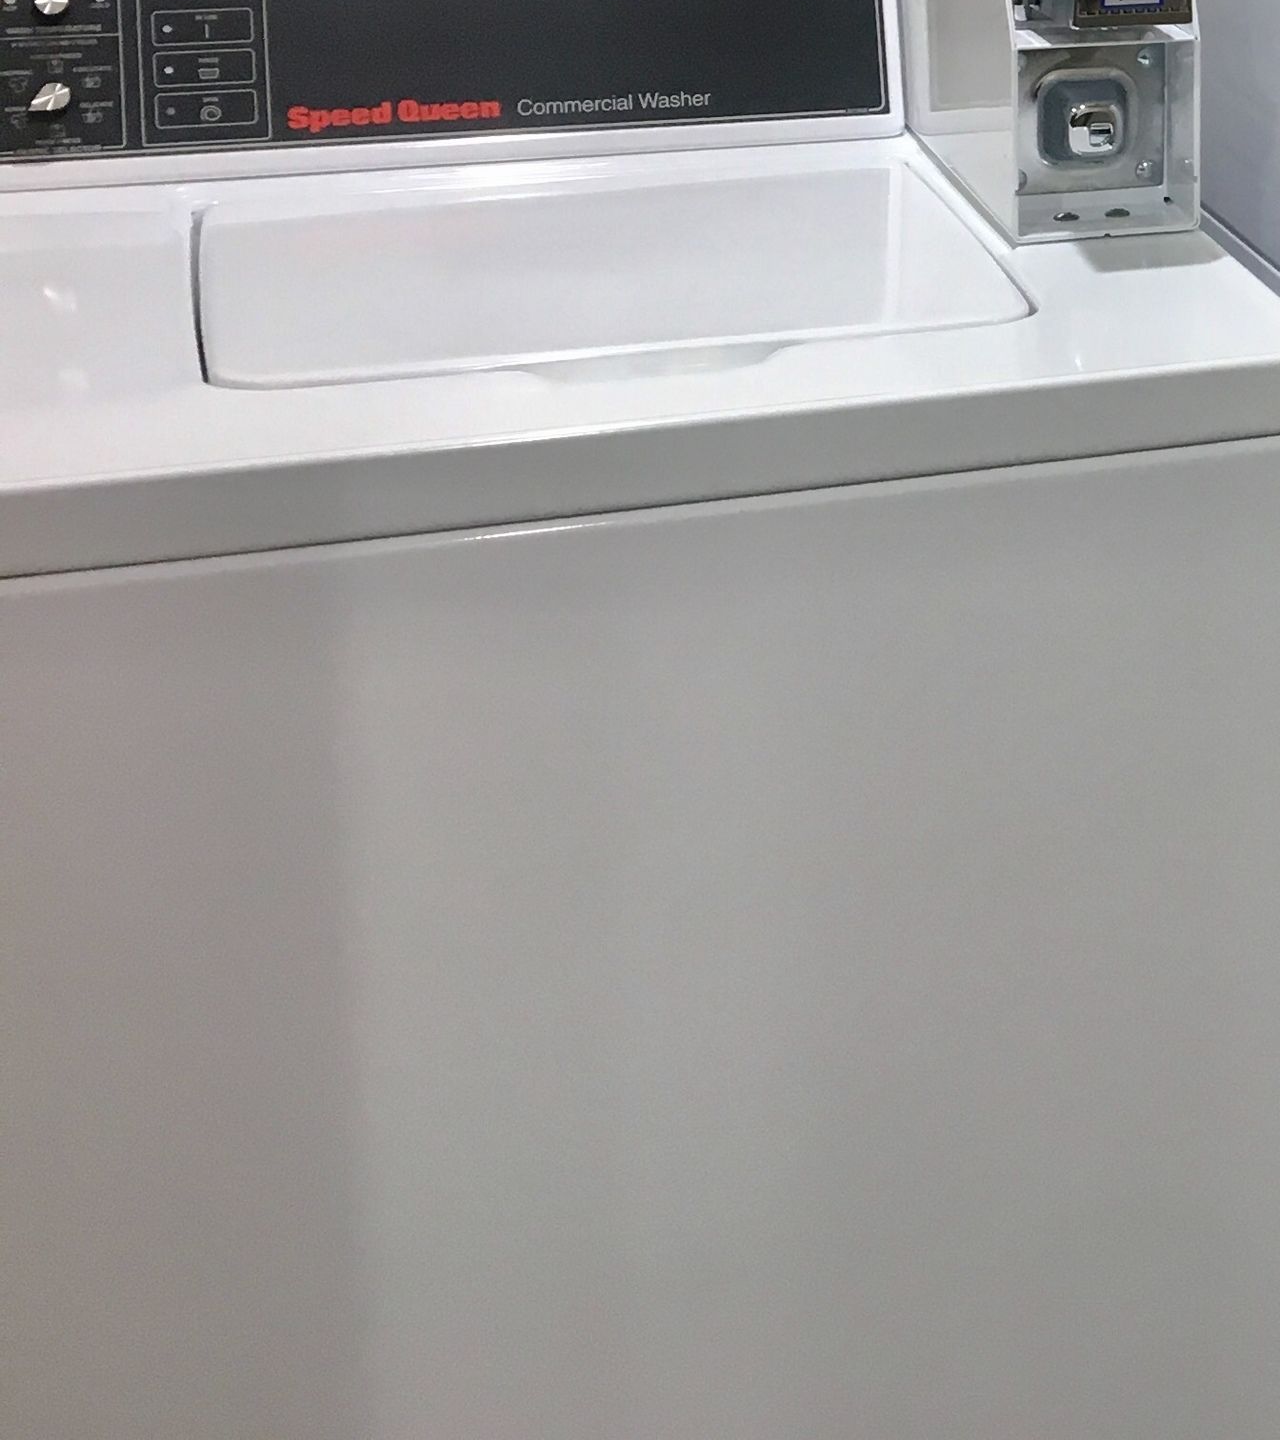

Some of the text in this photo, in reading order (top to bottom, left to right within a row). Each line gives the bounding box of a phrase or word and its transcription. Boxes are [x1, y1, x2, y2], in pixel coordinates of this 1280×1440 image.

[287, 92, 711, 133] Speed Queen Commercial Washer
